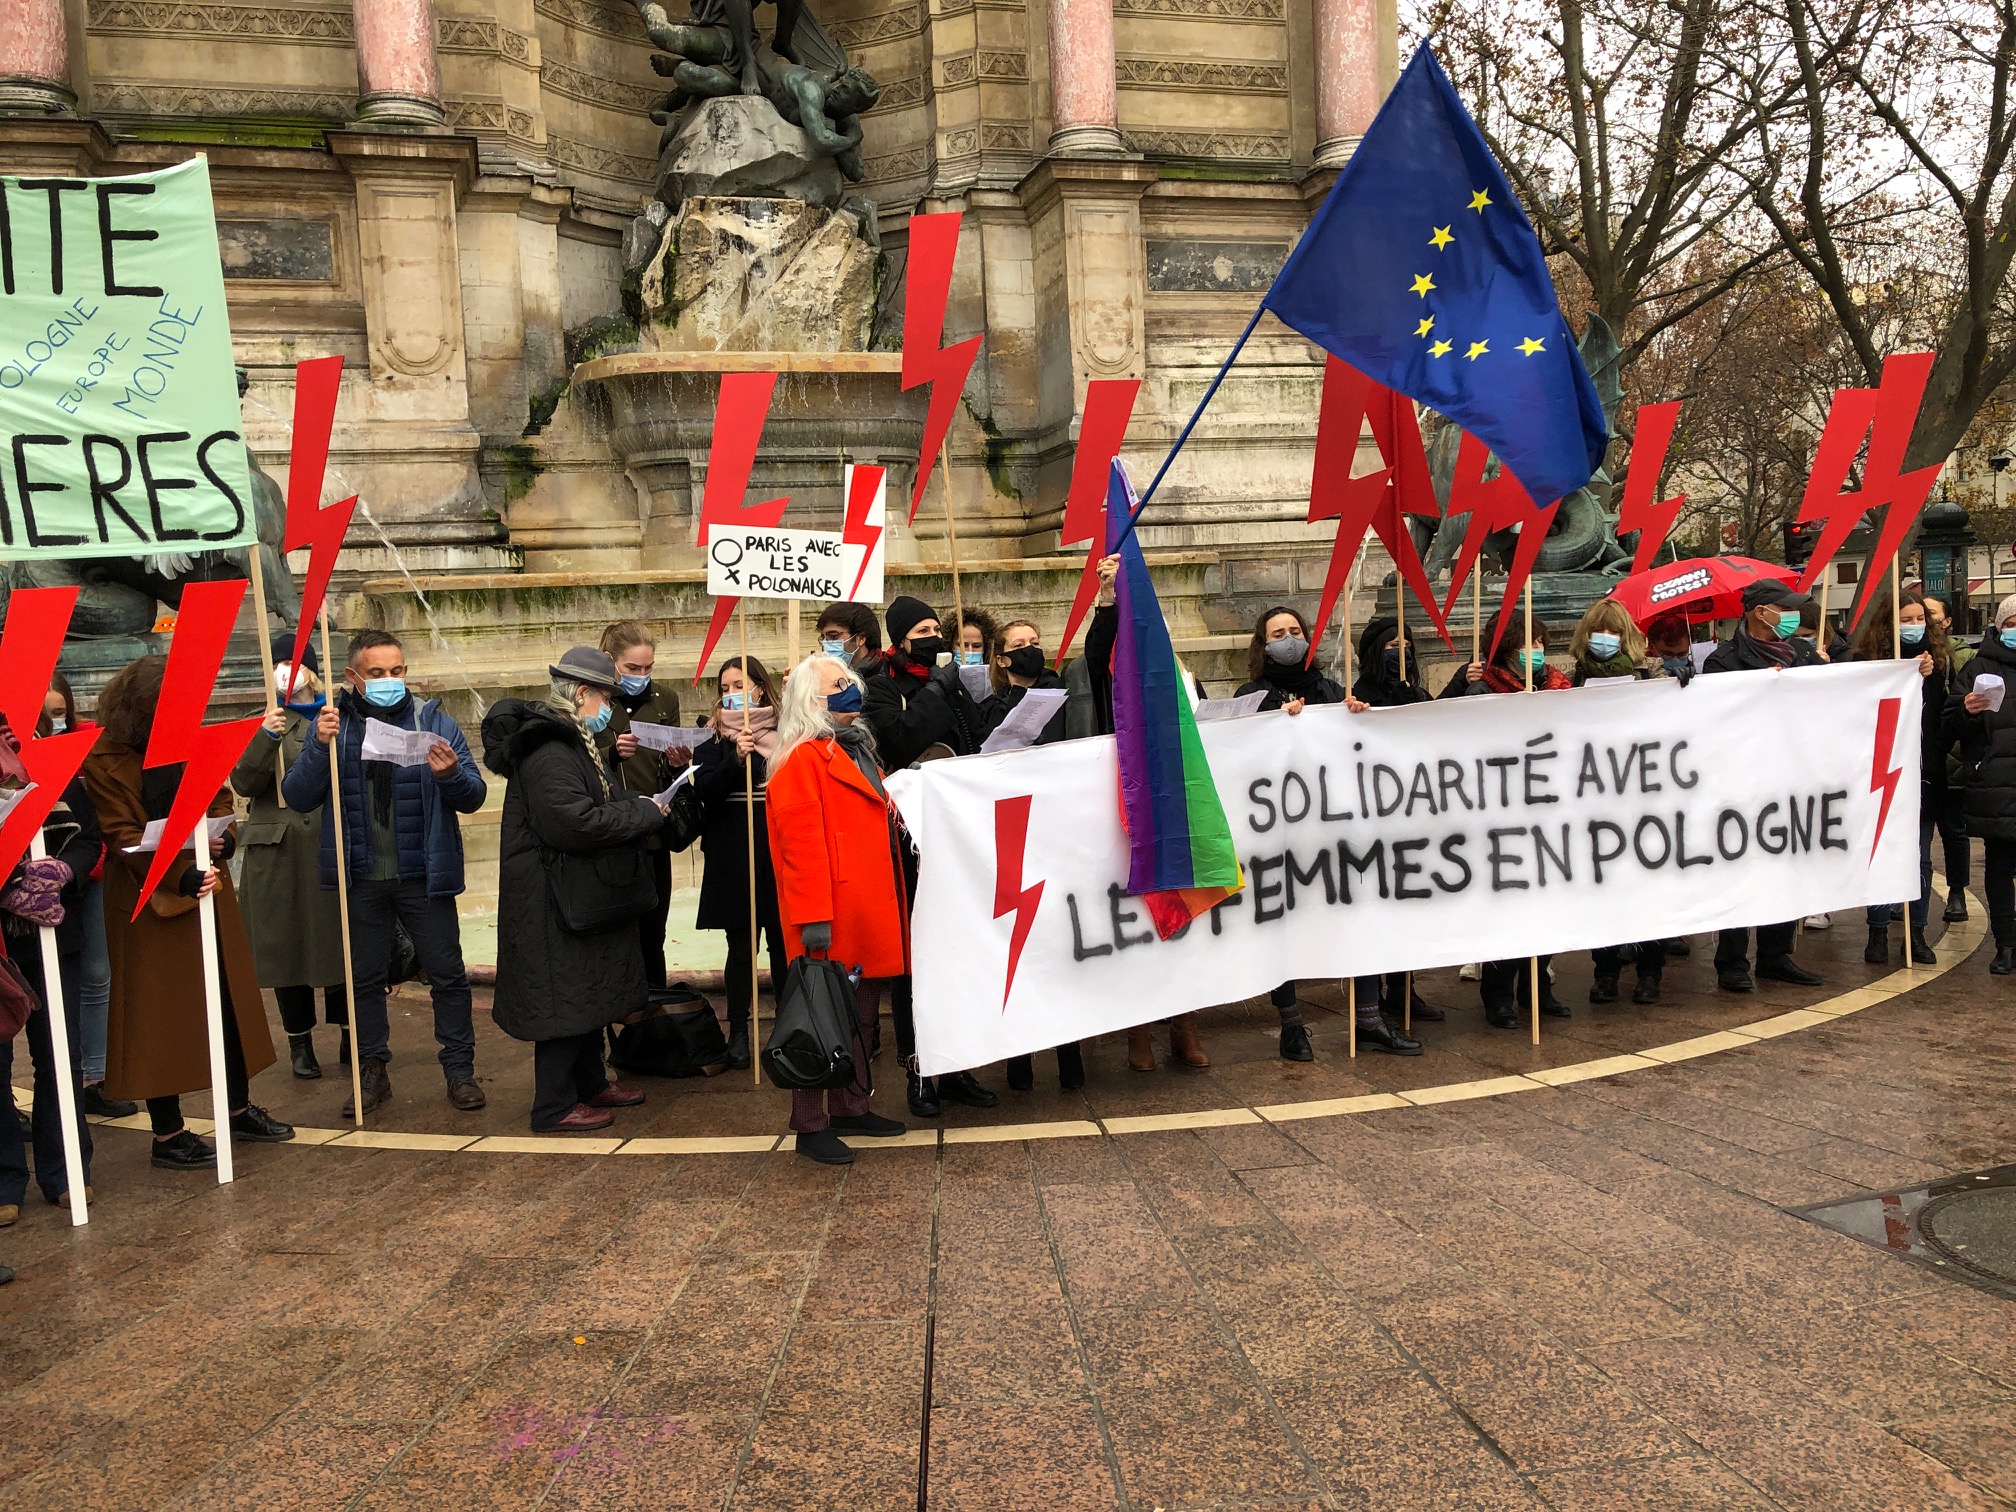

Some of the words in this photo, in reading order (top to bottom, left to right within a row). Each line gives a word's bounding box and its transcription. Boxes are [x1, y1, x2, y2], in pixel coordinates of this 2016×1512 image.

[56, 331, 130, 415] EUROPE
[112, 293, 203, 419] MONDE
[745, 536, 791, 552] PARIS
[805, 538, 842, 557] AVEC
[769, 554, 809, 573] LES
[749, 574, 842, 598] POLONAISES
[1651, 577, 1711, 602] PROTEST
[1249, 732, 1559, 833] SOLIDARITÉ
[1577, 740, 1699, 798] AVEC
[1067, 883, 1192, 962] LE
[1488, 823, 1573, 892] EN
[1588, 790, 1849, 884] POLOGNE
